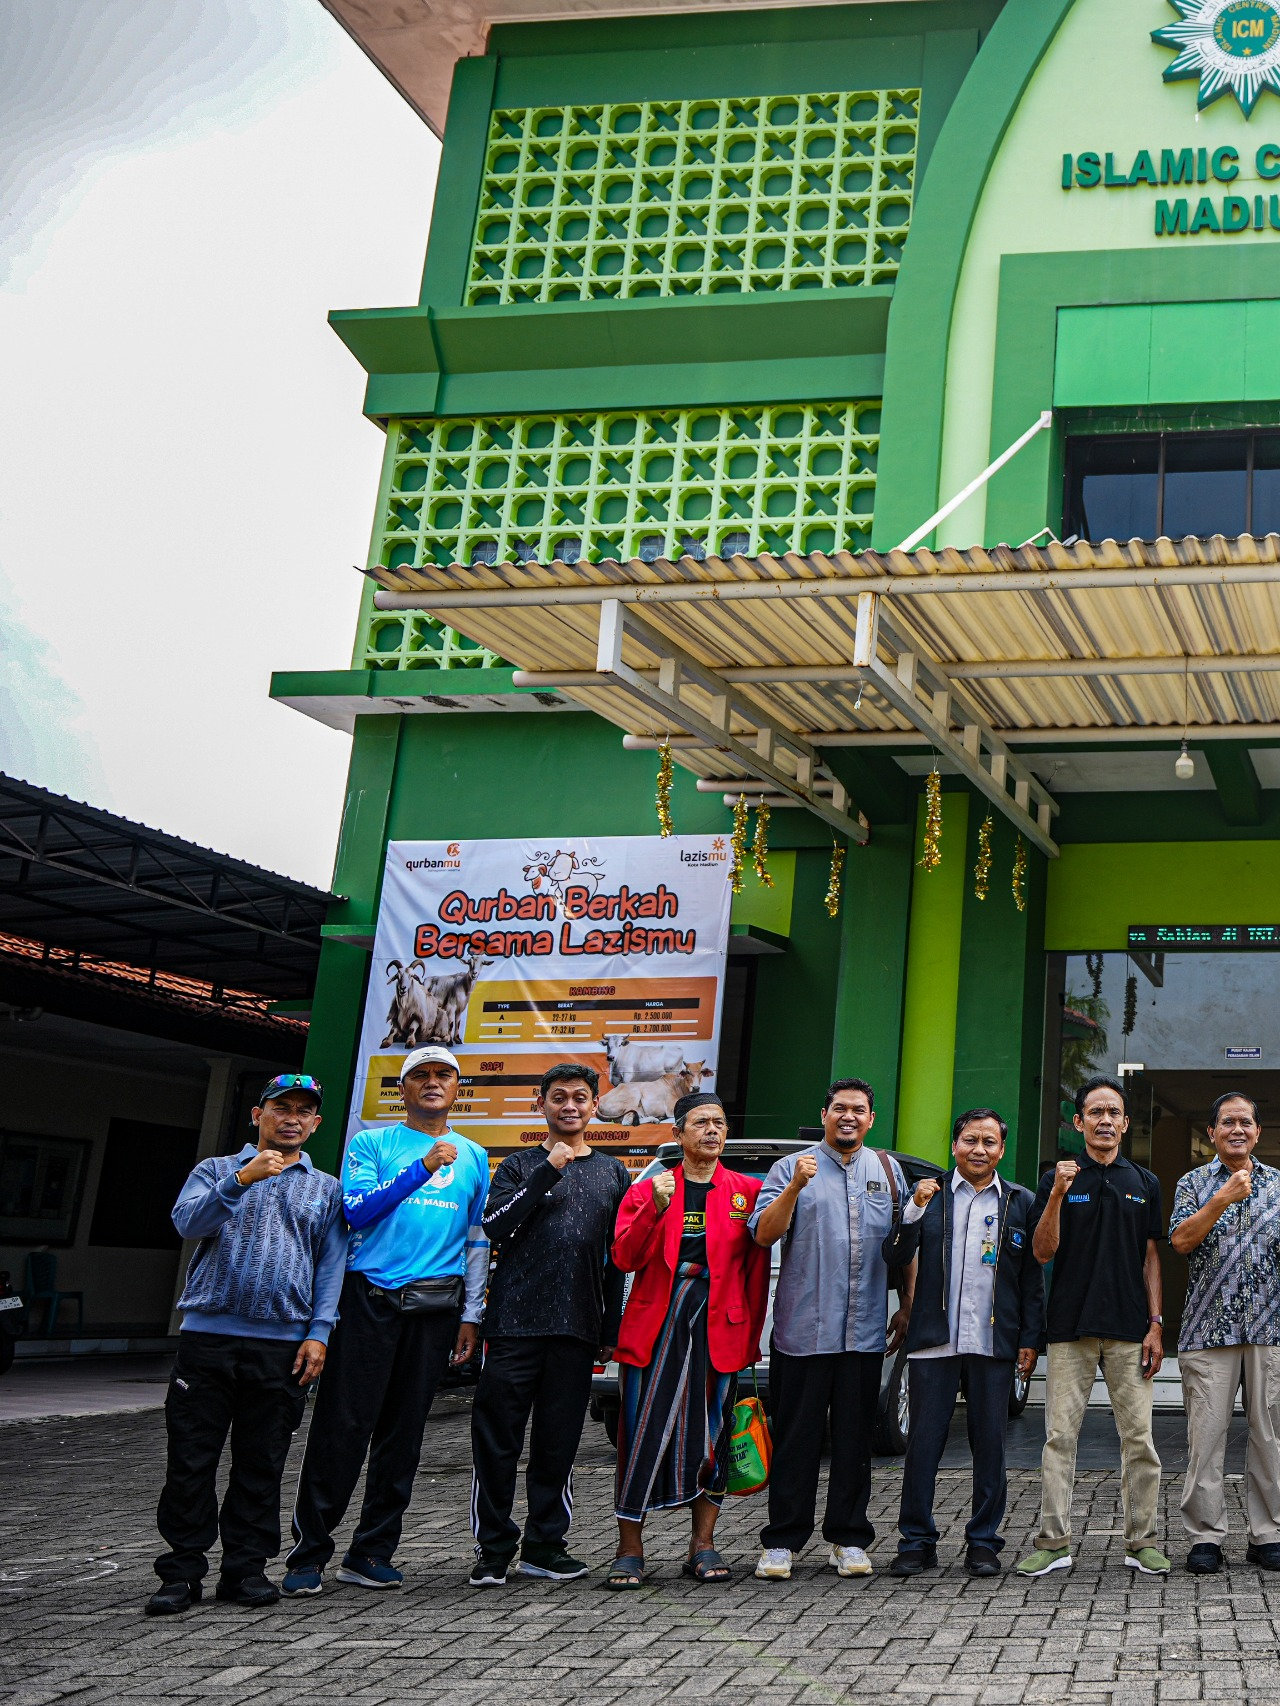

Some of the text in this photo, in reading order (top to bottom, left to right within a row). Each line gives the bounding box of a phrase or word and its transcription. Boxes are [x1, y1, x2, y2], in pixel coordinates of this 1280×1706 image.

[1215, 1, 1280, 52] ISLAMIC CENTRE MADIUN
[1232, 20, 1265, 38] ICM
[1061, 145, 1240, 190] ISLAMIC
[405, 857, 461, 872] qurbanmu
[680, 849, 727, 862] lazismu
[438, 884, 678, 924] Qurban Berkah
[413, 921, 696, 959] Bersama Lazismu
[569, 986, 616, 997] KAMBING
[480, 1061, 504, 1072] SAPI
